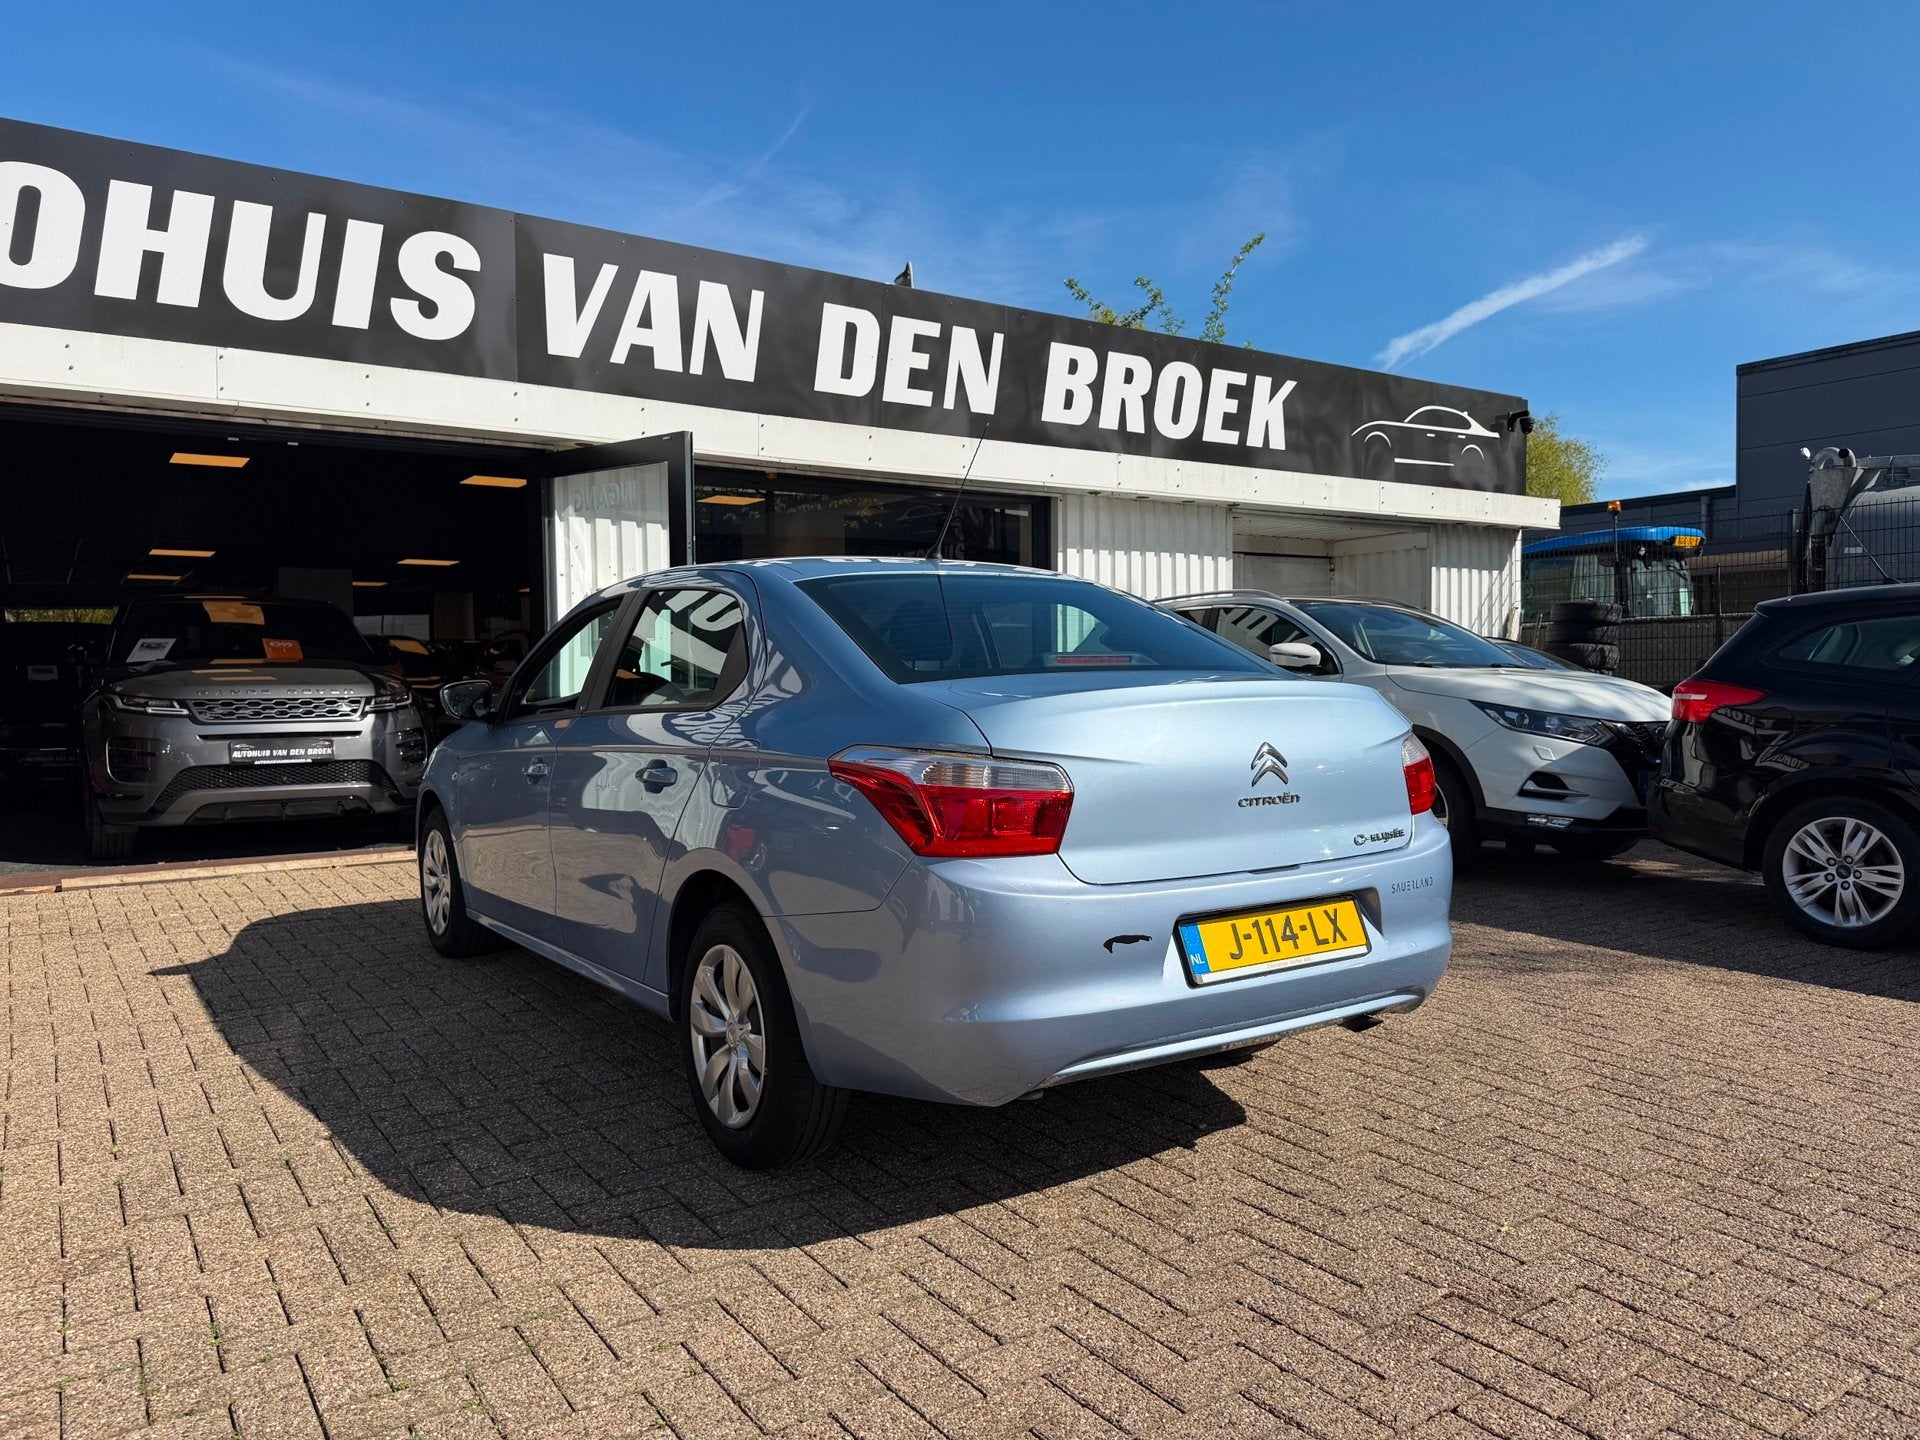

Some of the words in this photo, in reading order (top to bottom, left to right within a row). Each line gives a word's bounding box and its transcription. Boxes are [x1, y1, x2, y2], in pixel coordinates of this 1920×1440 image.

[0, 160, 482, 341] OHUIS
[543, 252, 765, 382] VAN
[814, 302, 1005, 416] DEN
[1041, 341, 1298, 451] BROEK
[232, 749, 271, 758] AUTOHUIS
[272, 748, 288, 757] VAN
[289, 748, 306, 756] DEN
[307, 747, 333, 756] BROEK
[1391, 876, 1434, 894] SAUERLAND
[1229, 908, 1348, 960] J-114-LX
[1191, 953, 1206, 966] NL
